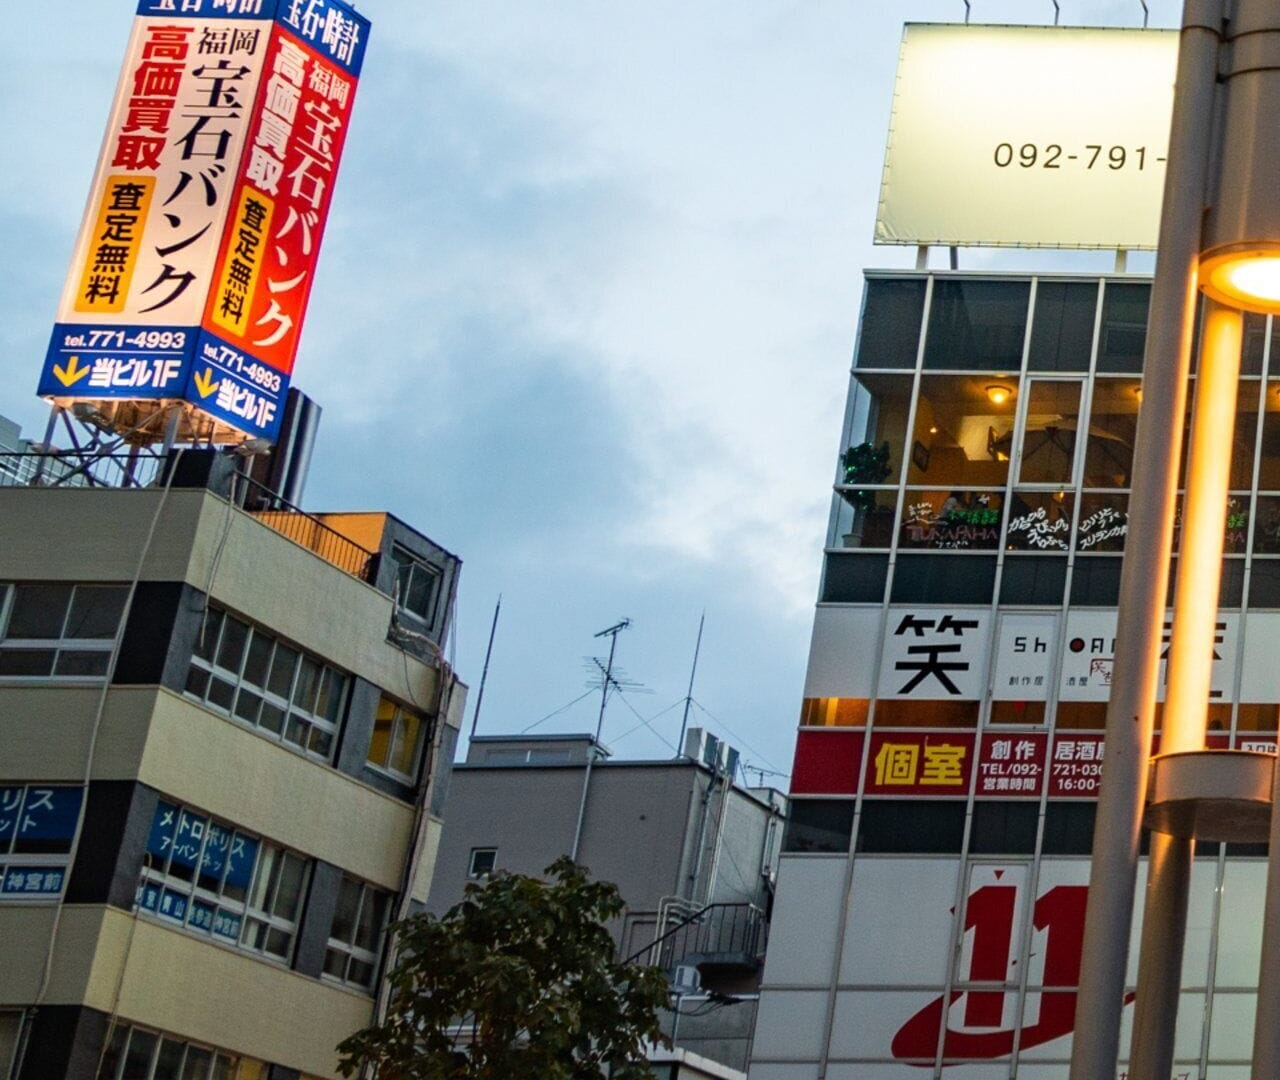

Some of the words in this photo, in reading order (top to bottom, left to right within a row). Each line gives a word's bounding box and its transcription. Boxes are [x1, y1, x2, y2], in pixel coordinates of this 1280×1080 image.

[197, 27, 261, 56] 福岡
[111, 25, 196, 171] 高価買取
[244, 36, 303, 197] 高価買取
[309, 61, 351, 110] 福岡
[138, 60, 251, 315] 宝石バンク
[252, 100, 341, 347] 宝石バンク
[86, 182, 145, 306] 査定無料
[220, 196, 267, 324] 査定無料
[91, 358, 181, 390] 当ビル1F
[894, 614, 979, 695] 笑
[875, 742, 966, 787] 個室
[983, 778, 1035, 791] 営業時間
[160, 811, 245, 859] メトロポリス
